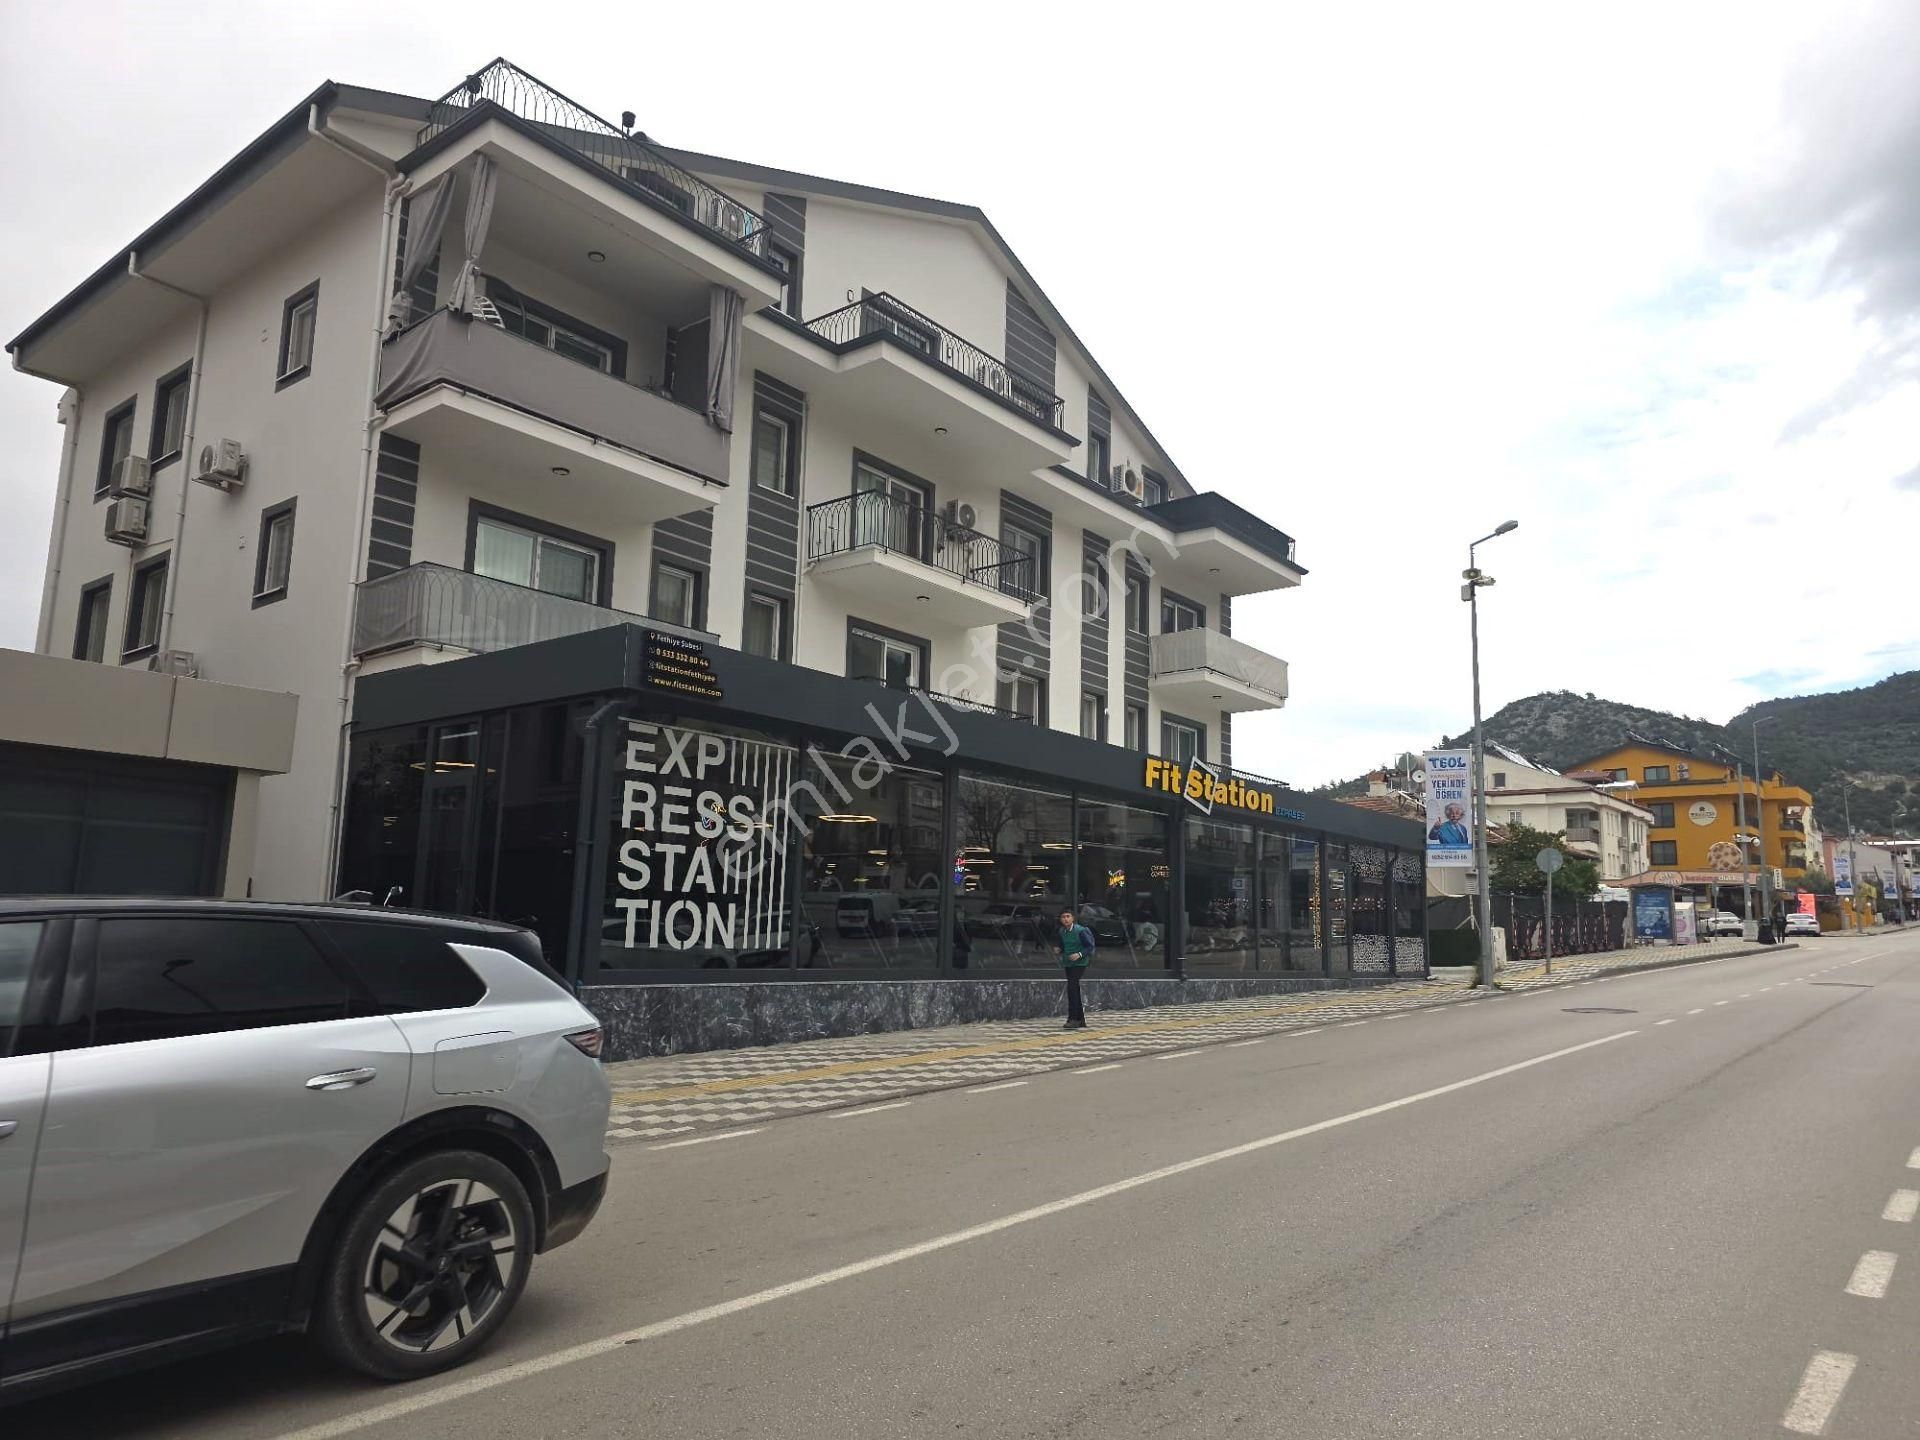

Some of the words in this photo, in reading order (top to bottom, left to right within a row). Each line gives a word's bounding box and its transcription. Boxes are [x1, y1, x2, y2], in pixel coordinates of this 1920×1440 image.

[657, 633, 680, 647] Fethiye
[656, 648, 661, 656] 0
[662, 649, 675, 659] 533
[689, 656, 698, 664] 80
[699, 659, 709, 667] 44
[654, 678, 722, 697] www.fitstation.com
[626, 721, 726, 780] EXP
[1429, 756, 1466, 769] TEOL
[1145, 757, 1182, 794] Fit
[1186, 769, 1273, 814] Station
[1431, 777, 1466, 789] YERİNDE
[1435, 788, 1463, 800] ÖĞREN
[621, 779, 755, 842] RESS
[617, 839, 716, 894] STA
[615, 898, 737, 950] TION
